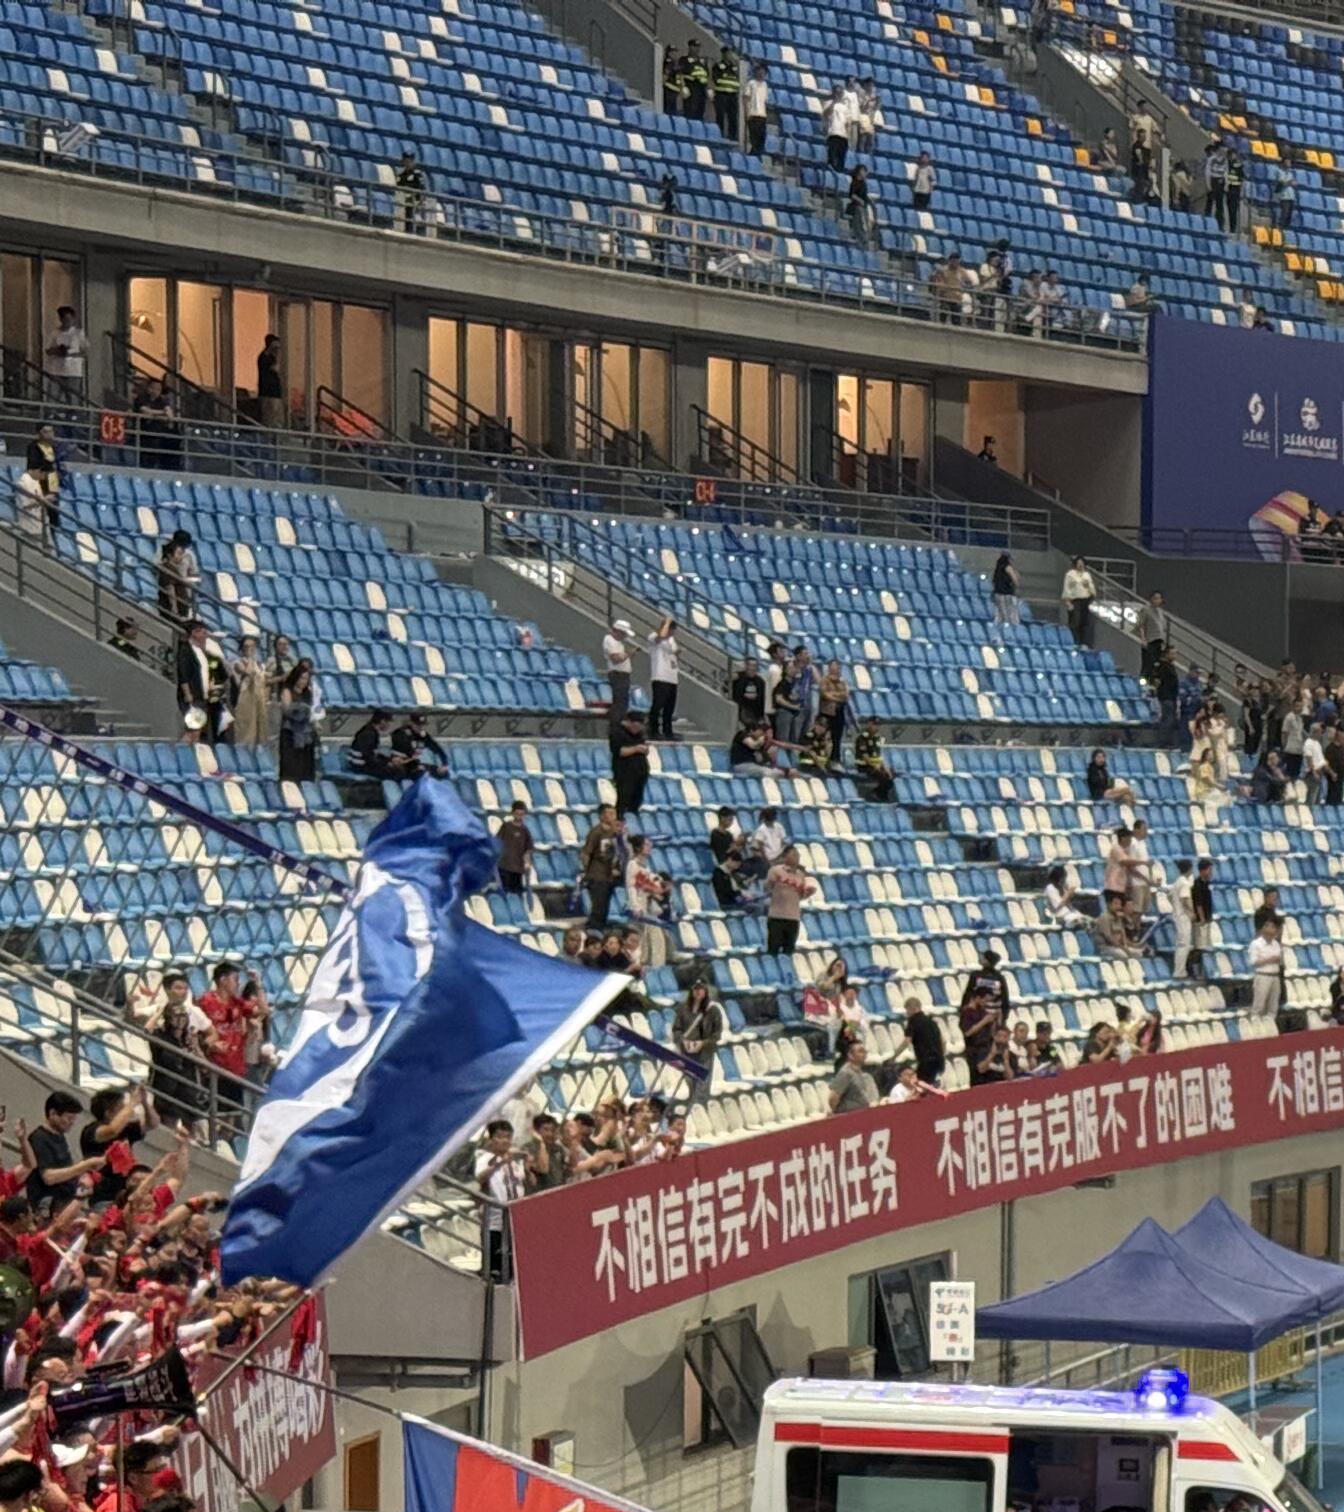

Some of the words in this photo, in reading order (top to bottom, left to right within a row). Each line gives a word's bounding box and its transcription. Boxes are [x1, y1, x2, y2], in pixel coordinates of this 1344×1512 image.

[592, 1128, 899, 1303] 不相信有完不成的任务
[935, 1062, 1235, 1197] 不相信有克服不了的困难
